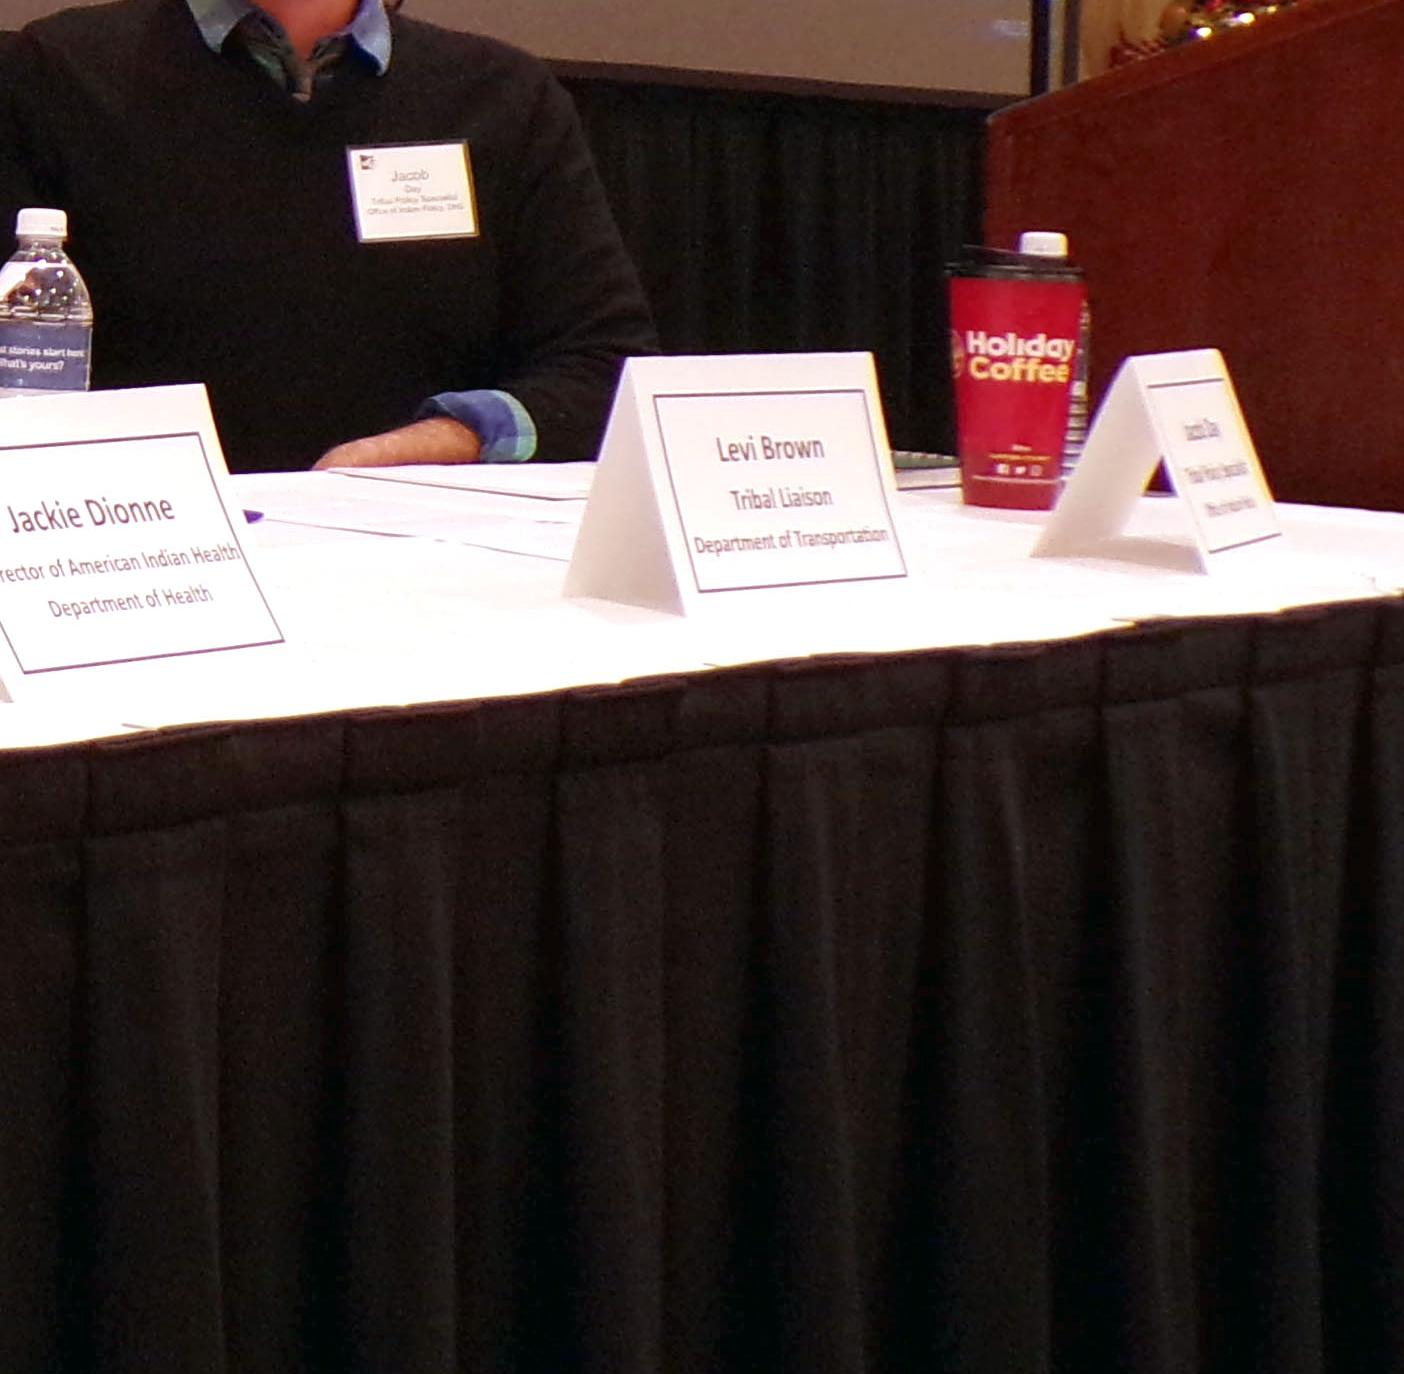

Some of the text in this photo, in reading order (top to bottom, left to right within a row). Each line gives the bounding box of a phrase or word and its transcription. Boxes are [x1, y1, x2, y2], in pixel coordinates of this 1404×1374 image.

[965, 330, 1075, 361] Holiday
[28, 359, 65, 372] yours?
[969, 356, 1070, 383] Coffee
[716, 435, 825, 462] Levi Brown
[729, 485, 833, 510] Tribal Liaison
[7, 496, 176, 534] Jackie Dionne
[694, 525, 889, 557] Department of Transportation
[49, 558, 64, 578] of
[68, 554, 142, 577] American
[141, 548, 191, 569] Indian
[190, 541, 241, 564] Health
[48, 583, 213, 620] Department of Health
